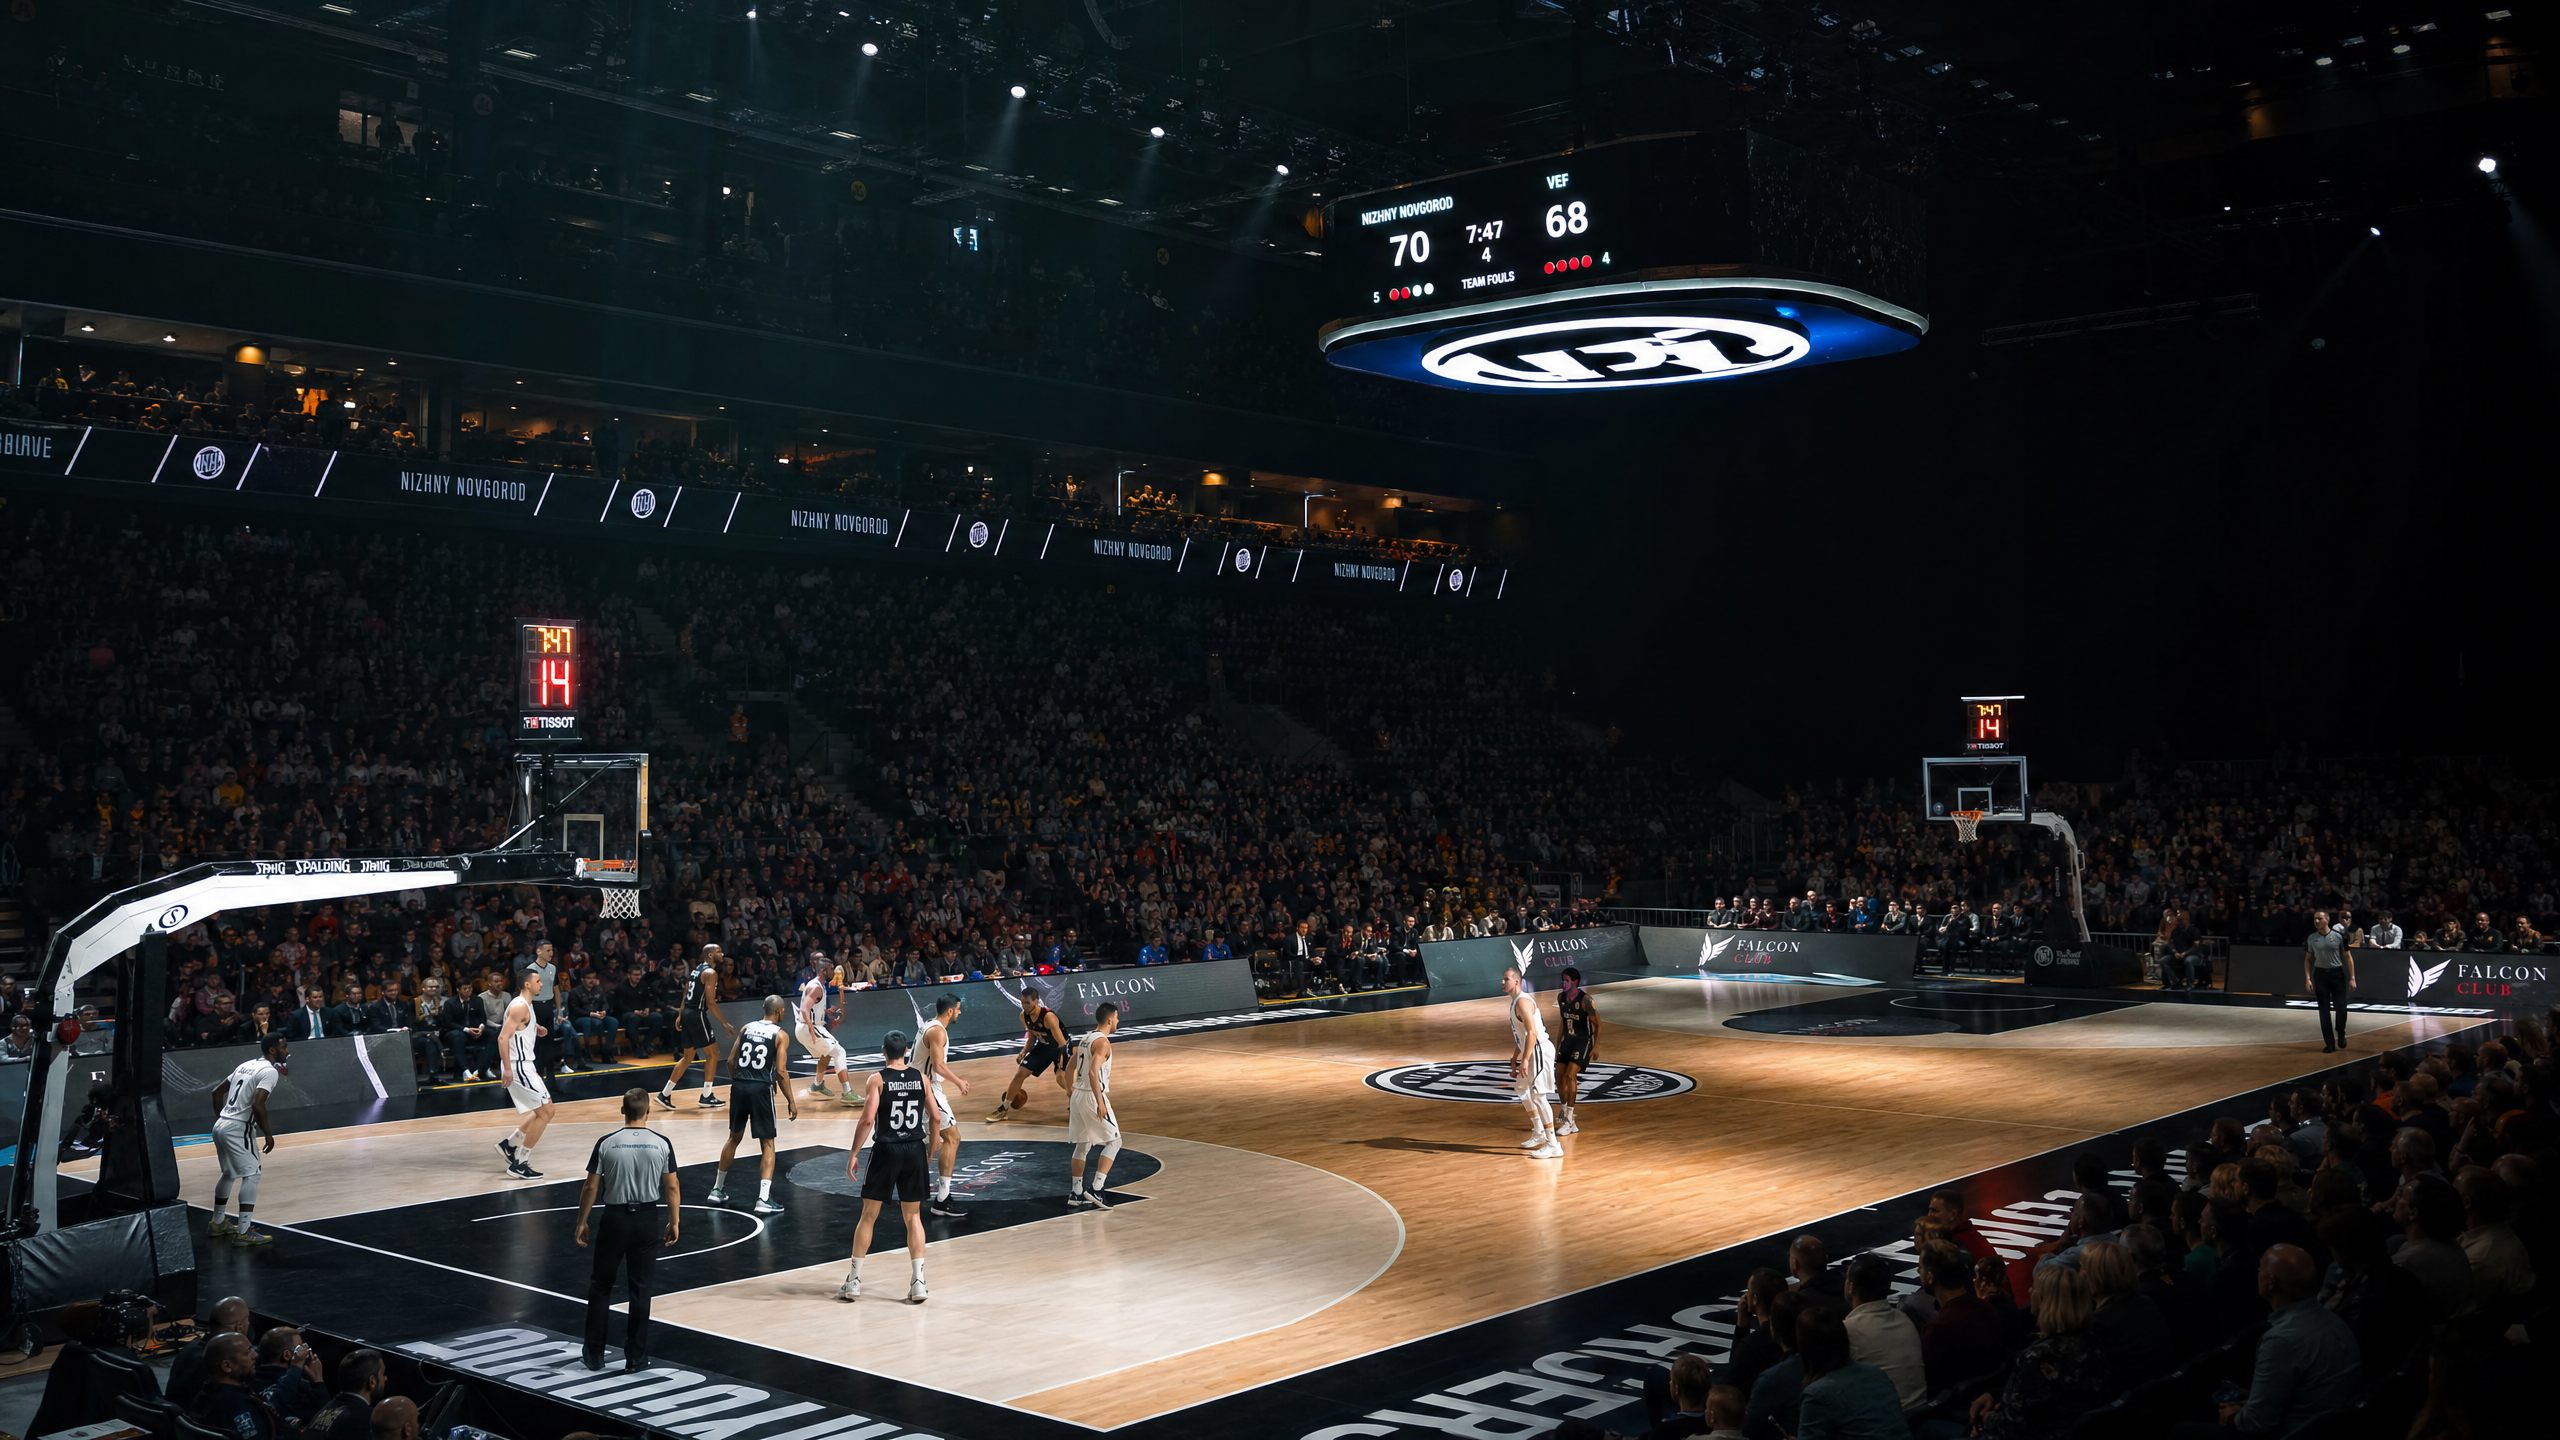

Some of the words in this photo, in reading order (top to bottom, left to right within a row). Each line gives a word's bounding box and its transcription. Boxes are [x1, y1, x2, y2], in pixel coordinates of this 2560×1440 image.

[1546, 172, 1570, 190] VEF
[1361, 206, 1398, 226] NIZHNY
[1399, 195, 1454, 219] NOVGOROD
[1545, 200, 1589, 239] 68
[1465, 220, 1504, 245] 7:47
[1388, 230, 1431, 268] 70
[1481, 246, 1492, 263] 4
[1601, 251, 1611, 265] 4
[1461, 274, 1487, 290] TEAM
[1487, 270, 1516, 287] FOULS
[1373, 291, 1381, 304] 5
[400, 471, 451, 495] NIZHNY
[456, 476, 526, 502] NOVGOROD
[790, 509, 831, 530] NIZHNY
[834, 513, 889, 536] NOVGOROD
[1093, 538, 1126, 558] NIZHNY
[1128, 541, 1172, 562] NOVGOROD
[1334, 562, 1360, 579] NIZHNY
[538, 627, 571, 654] 7:47
[541, 659, 571, 707] 14
[1976, 704, 2002, 717] 7:47
[539, 716, 575, 729] TISSOT
[1979, 718, 2000, 739] 14
[294, 859, 351, 875] SPALDING
[1538, 937, 1589, 954] FALCON
[1736, 939, 1801, 953] FALCON
[1544, 955, 1575, 968] CLUB
[2457, 964, 2547, 981] FALCON
[1076, 976, 1157, 999] FALCON
[2457, 982, 2511, 996] CLUB
[738, 1041, 768, 1070] 33
[889, 1099, 919, 1130] 55
